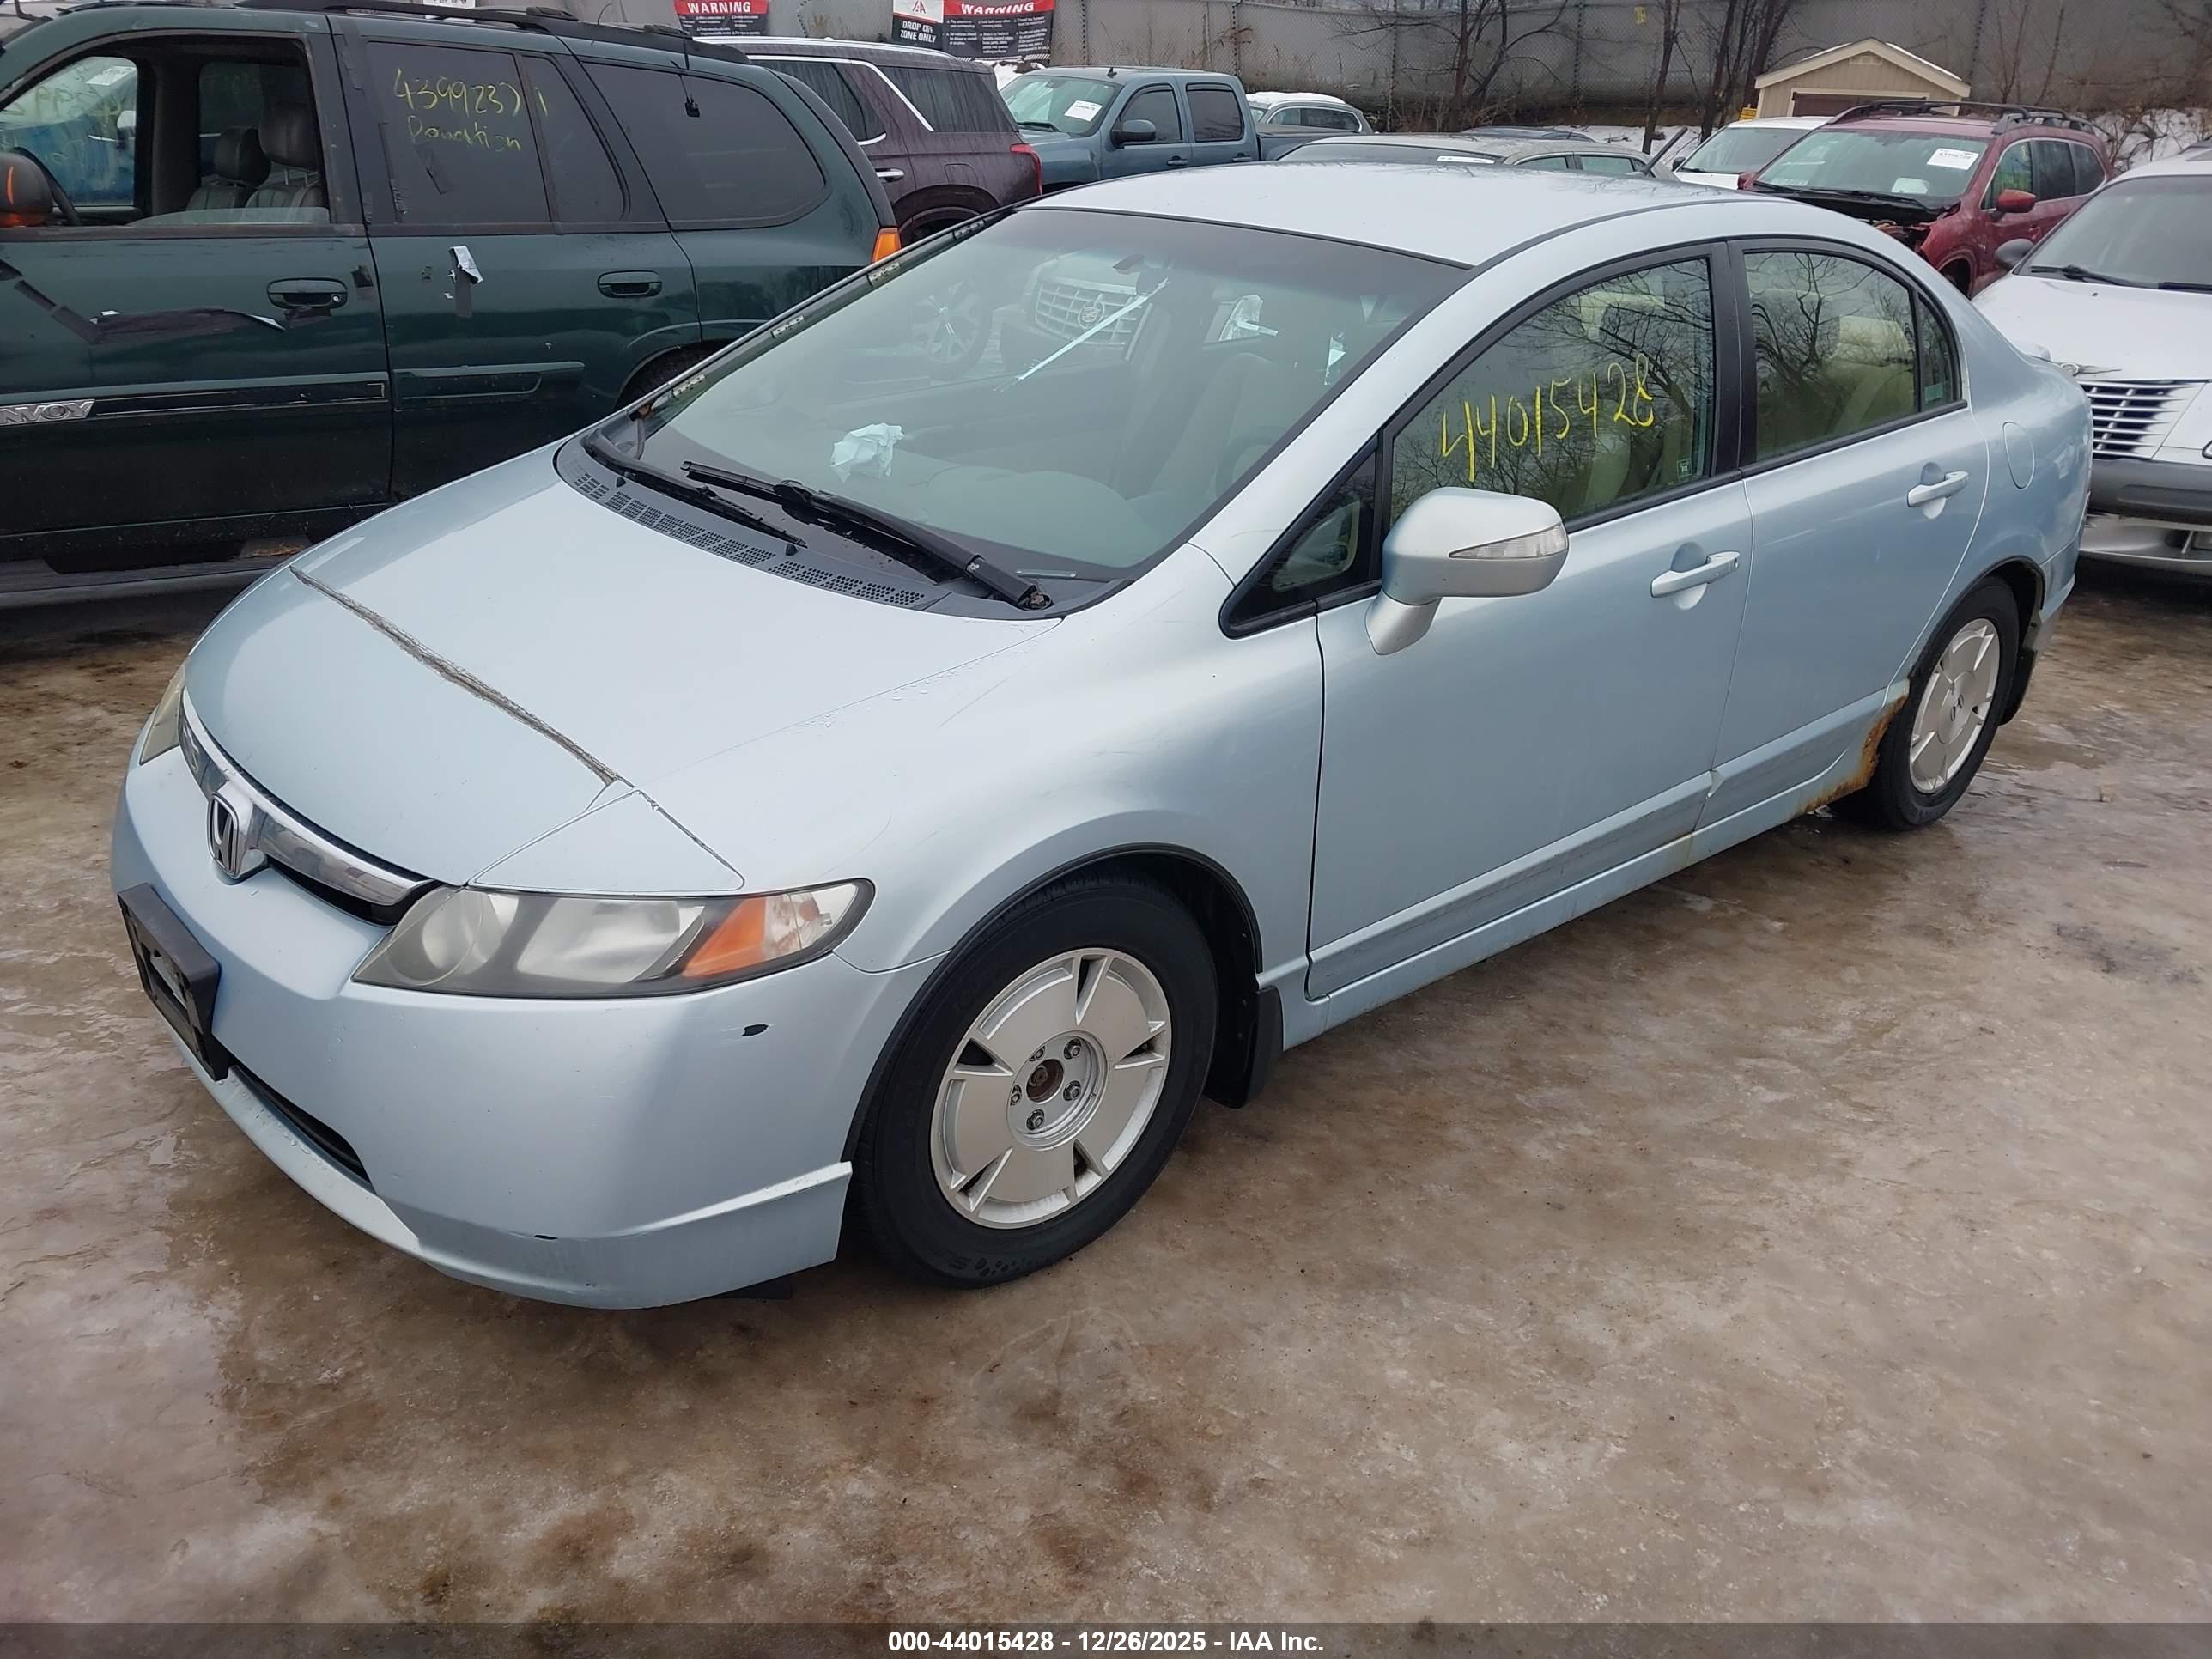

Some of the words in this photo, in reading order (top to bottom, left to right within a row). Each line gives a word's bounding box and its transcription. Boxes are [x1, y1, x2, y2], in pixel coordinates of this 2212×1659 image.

[687, 1, 751, 14] WARNING
[960, 2, 1034, 15] WARNING
[902, 20, 921, 31] DROP
[900, 29, 917, 40] ZONE
[918, 33, 936, 43] ONLY
[1441, 352, 1655, 482] 44015428
